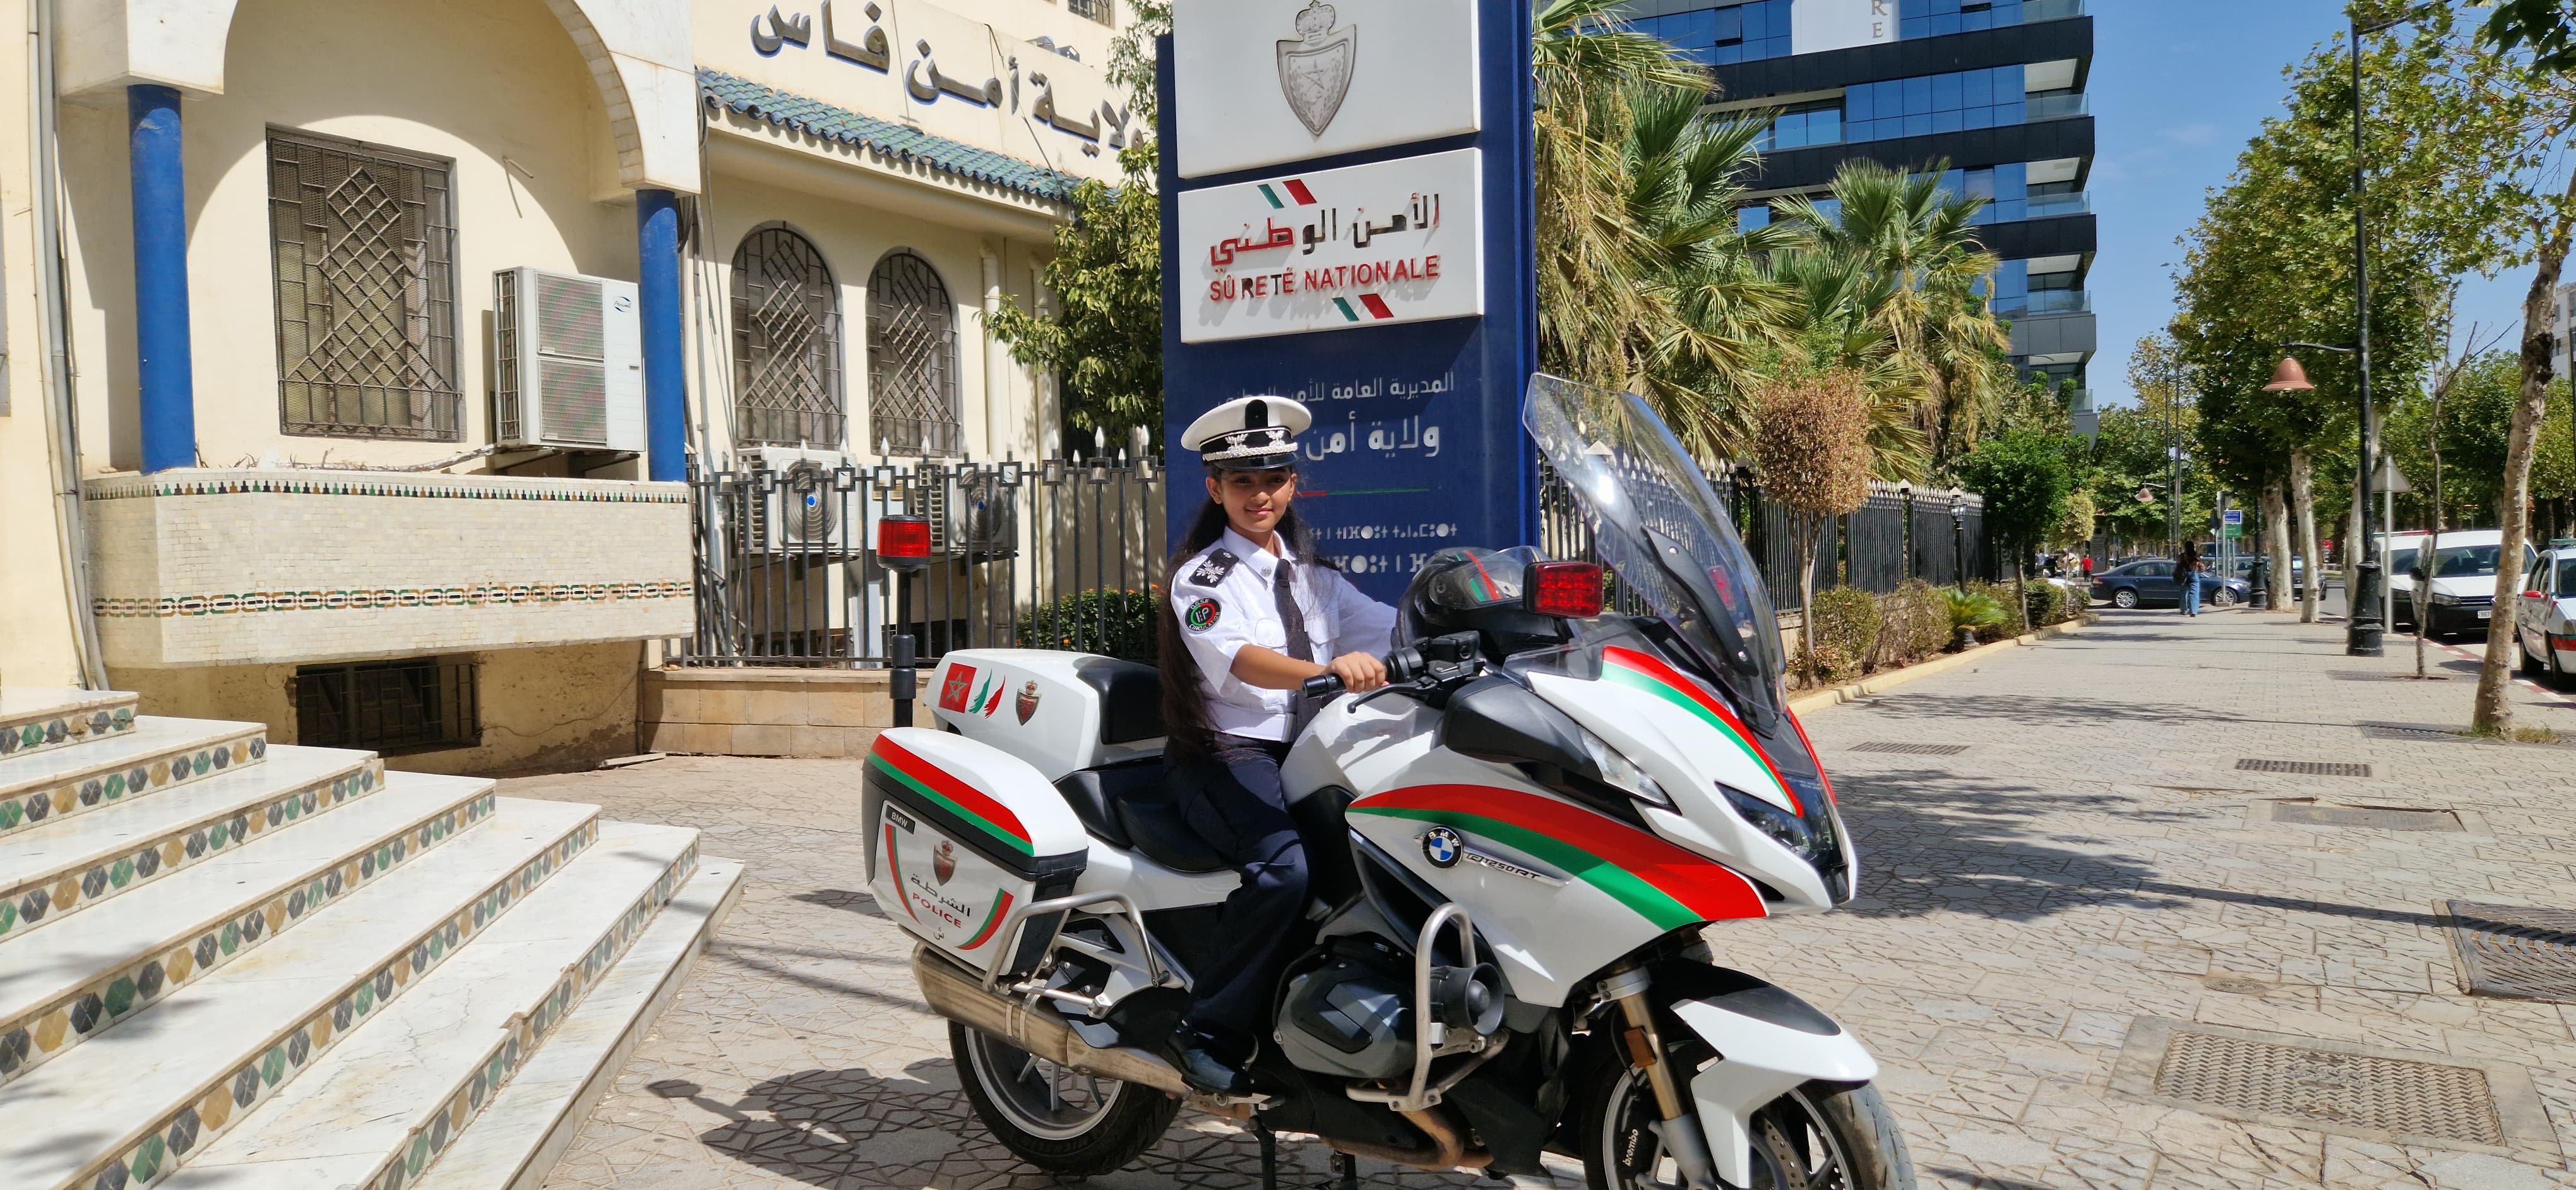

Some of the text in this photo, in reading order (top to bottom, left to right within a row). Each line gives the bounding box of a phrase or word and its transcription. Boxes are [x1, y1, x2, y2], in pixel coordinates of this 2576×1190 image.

[750, 0, 890, 76] فاس
[905, 38, 1020, 115] أمن
[1210, 191, 1440, 273] الأمن الوطني
[1304, 254, 1440, 292] NATIONALE
[1331, 378, 1383, 400] العامة
[1389, 371, 1455, 400] المديرية
[1304, 411, 1440, 461] ولاية أمن
[891, 811, 909, 827] BMW
[1428, 830, 1460, 847] BMW
[910, 873, 970, 917] الشرطة
[912, 892, 962, 929] POLICE
[1622, 1128, 1639, 1167] brembo
